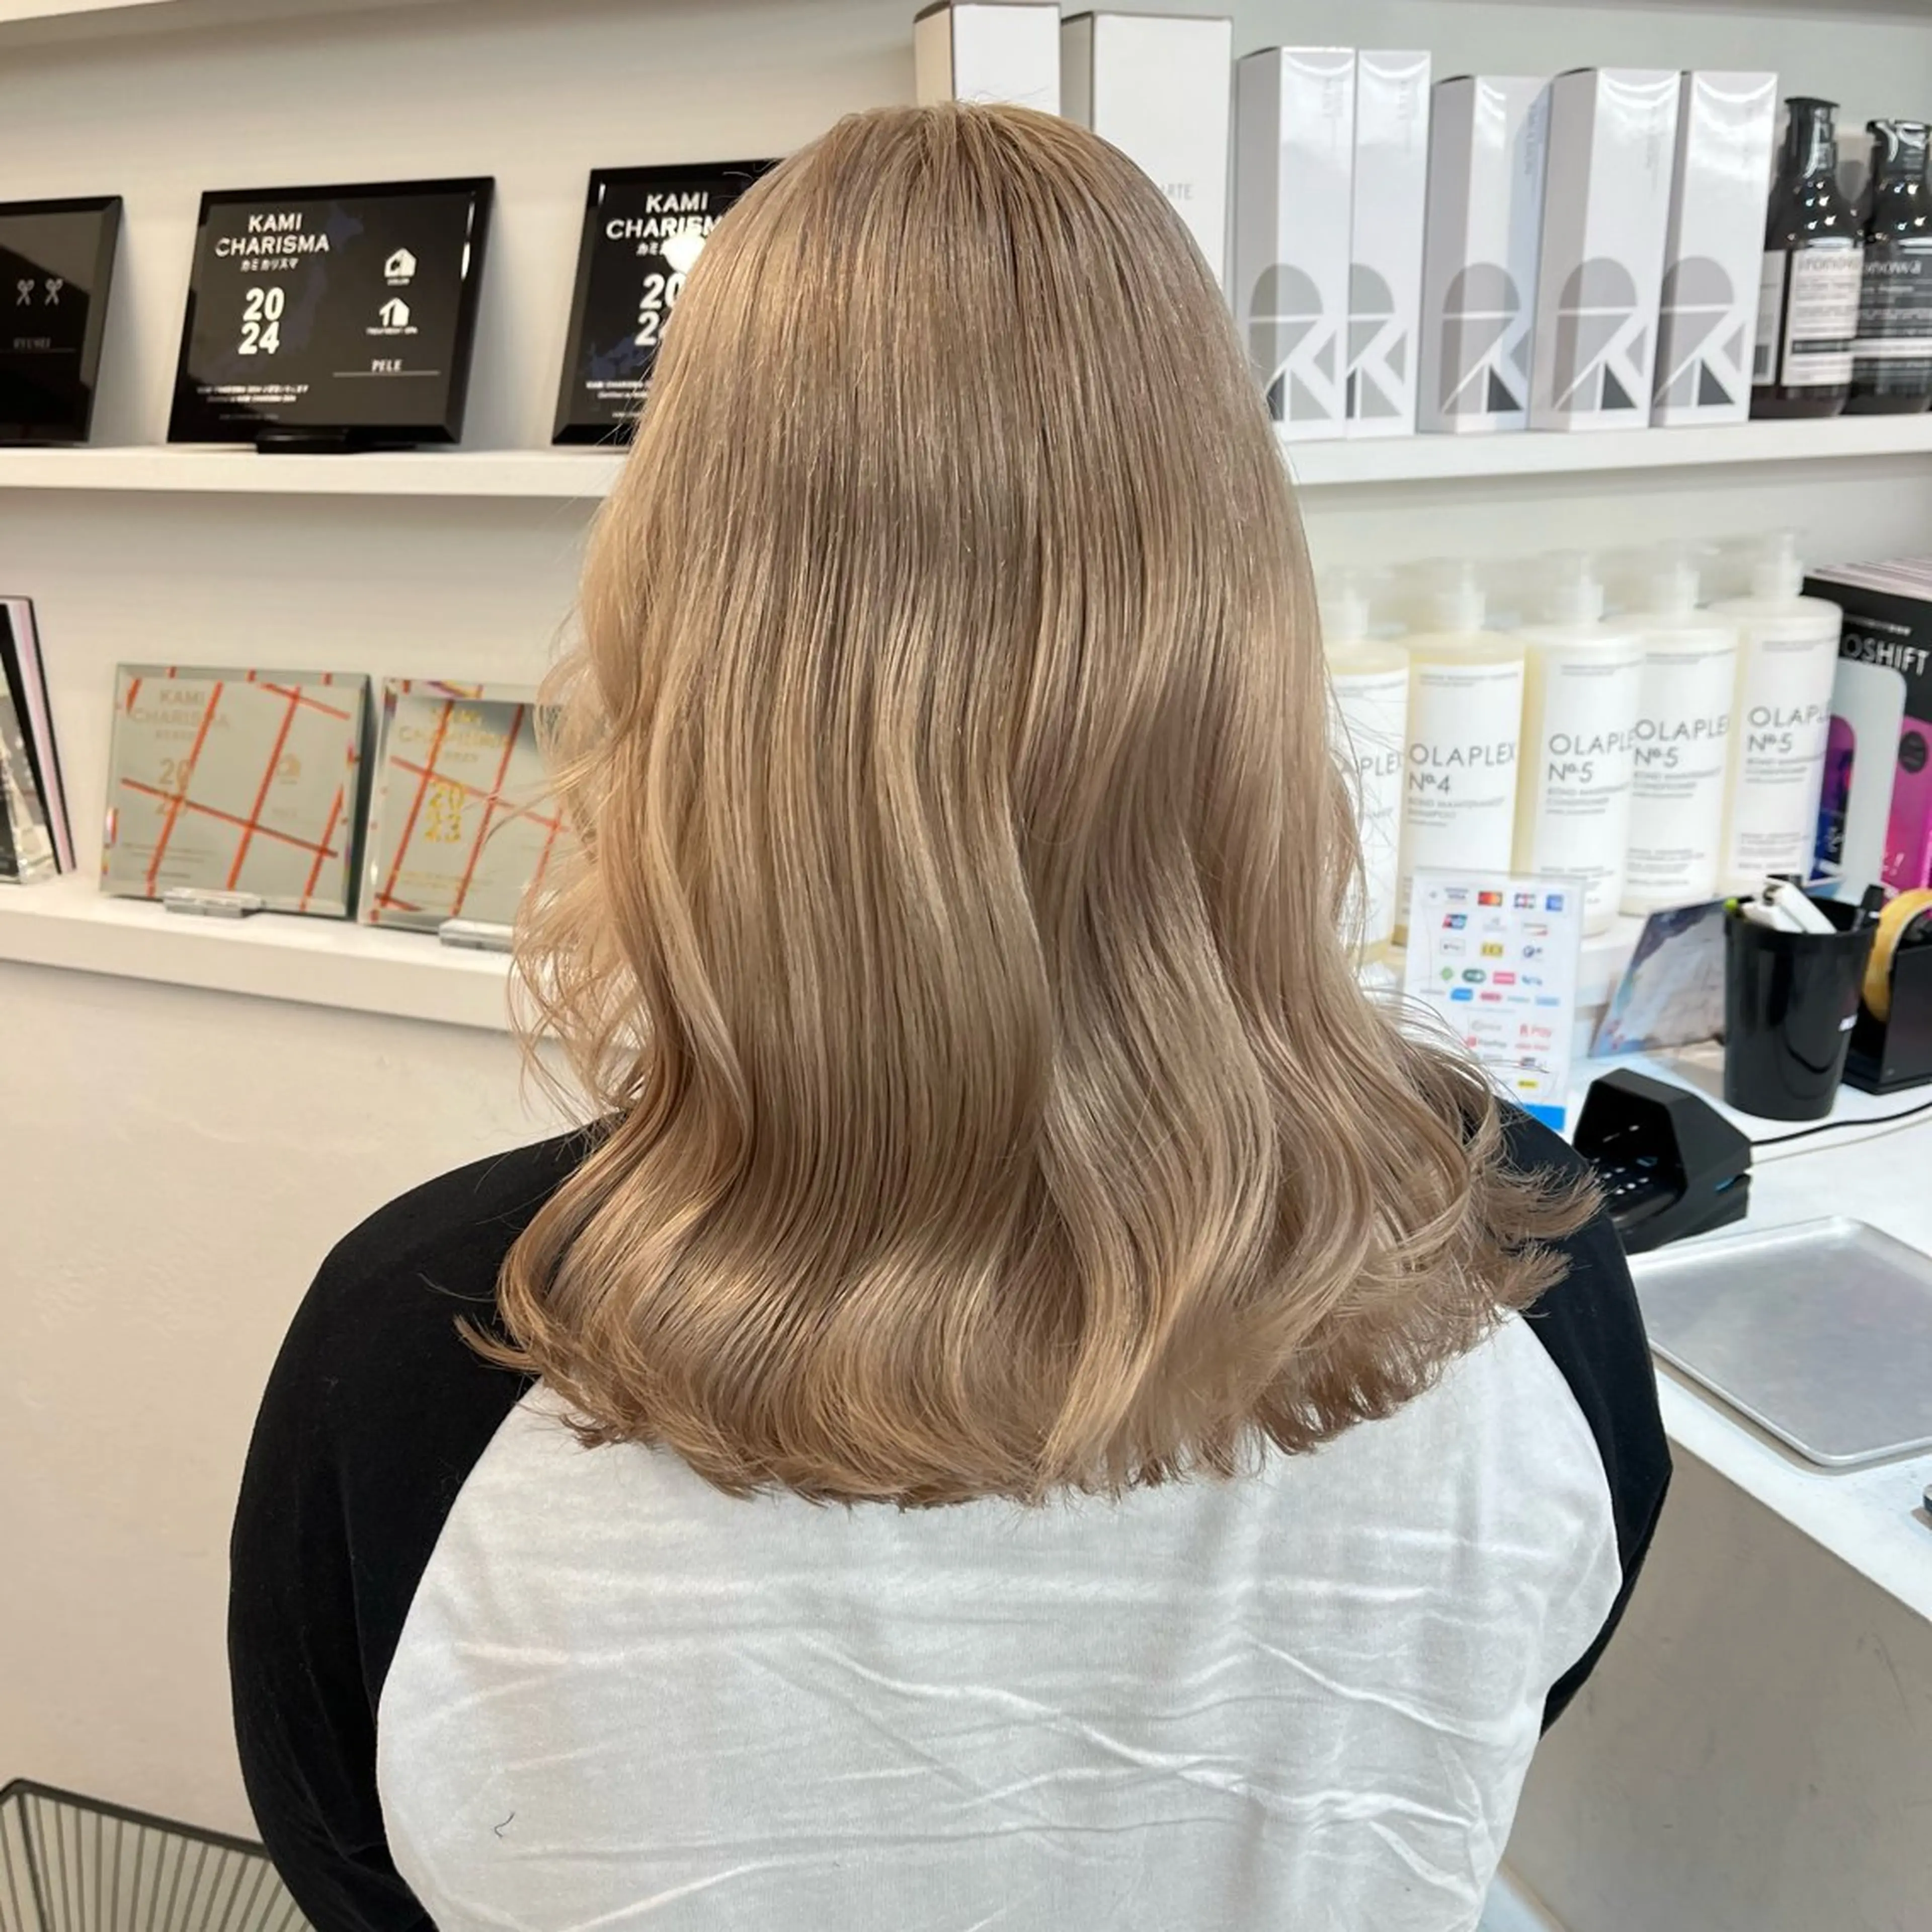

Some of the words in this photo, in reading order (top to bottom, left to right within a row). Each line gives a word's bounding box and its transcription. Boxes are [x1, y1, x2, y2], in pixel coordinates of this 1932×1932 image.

[646, 192, 708, 213] KAMI
[248, 212, 302, 233] KAMI
[606, 216, 723, 239] CHARISM
[215, 233, 330, 257] CHARISMA
[243, 287, 285, 321] 20
[238, 321, 280, 355] 24
[634, 311, 663, 346] 2
